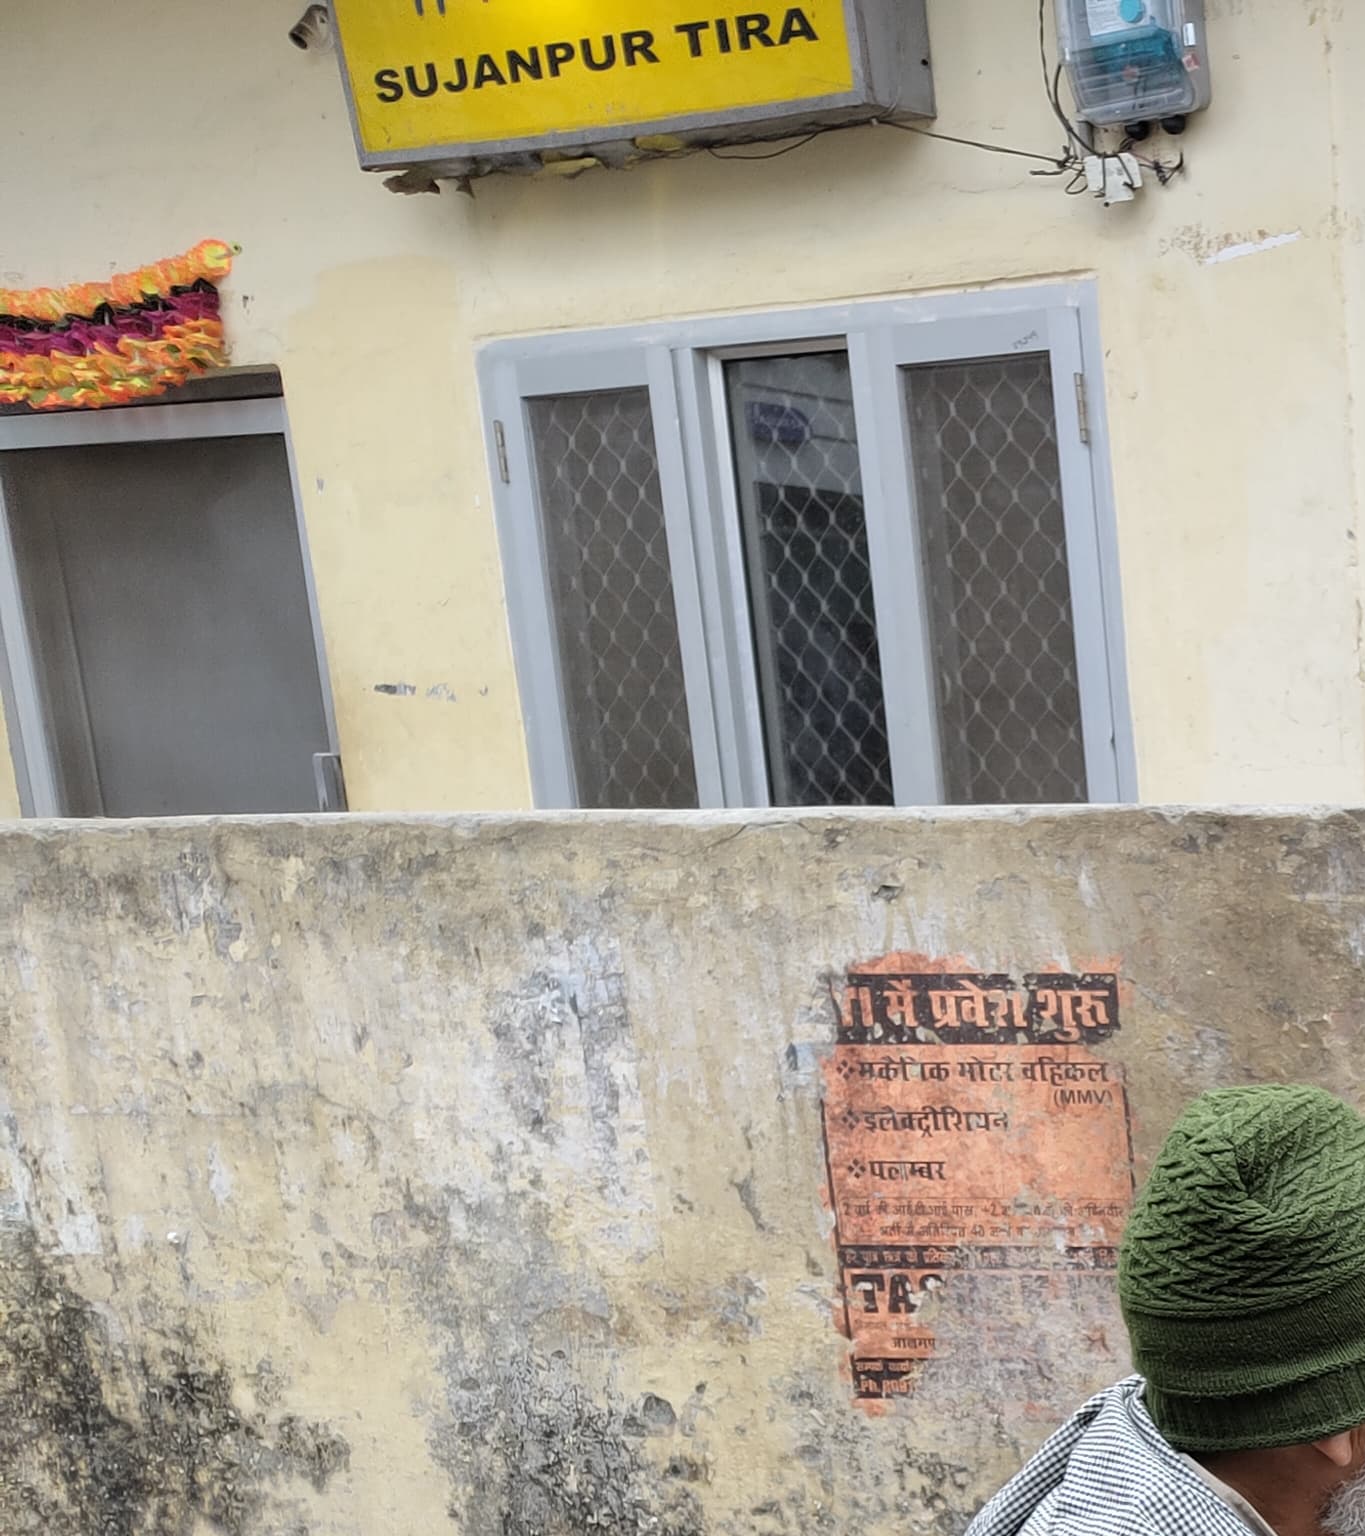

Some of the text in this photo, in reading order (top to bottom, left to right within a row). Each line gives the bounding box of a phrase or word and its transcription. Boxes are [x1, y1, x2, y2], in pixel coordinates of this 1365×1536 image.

[374, 7, 818, 103] SUJANPUR TIRA
[1053, 1089, 1113, 1108] (MMV)
